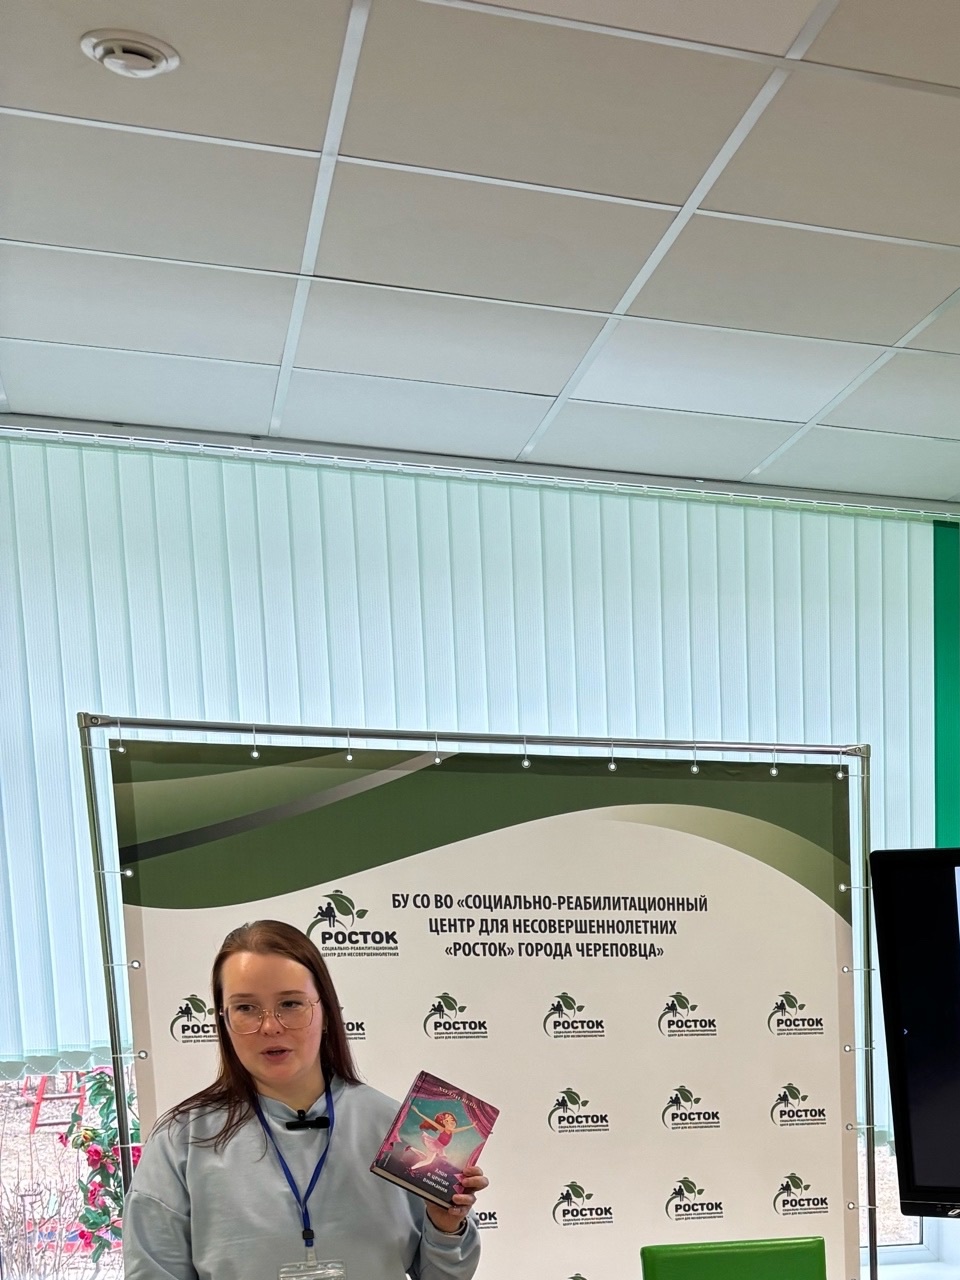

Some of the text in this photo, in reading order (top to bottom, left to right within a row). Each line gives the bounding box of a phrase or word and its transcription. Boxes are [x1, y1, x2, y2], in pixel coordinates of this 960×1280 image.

[392, 894, 708, 912] БУ СО ВО «СОЦИАЛЬНО-РЕАБИЛИТАЦИОННЫЙ
[429, 918, 677, 935] ЦЕНТР ДЛЯ НЕСОВЕРШЕННОЛЕТНИХ
[321, 931, 398, 944] РОСТОК
[444, 942, 664, 960] «РОСТОК» ГОРОДА ЧЕРЕПОВЦА»
[434, 1021, 487, 1031] РОСТОК
[553, 1020, 604, 1030] РОСТОК
[668, 1018, 716, 1029] РОСТОК
[777, 1018, 823, 1027] РОСТОК
[181, 1024, 218, 1034] РОСТ
[671, 1111, 720, 1121] РОСТОК
[779, 1108, 826, 1118] РОСТОК
[558, 1114, 609, 1124] РОСТОК
[674, 1201, 723, 1213] РОСТОК
[782, 1197, 828, 1208] РОСТОК
[562, 1206, 613, 1219] РОСТОК
